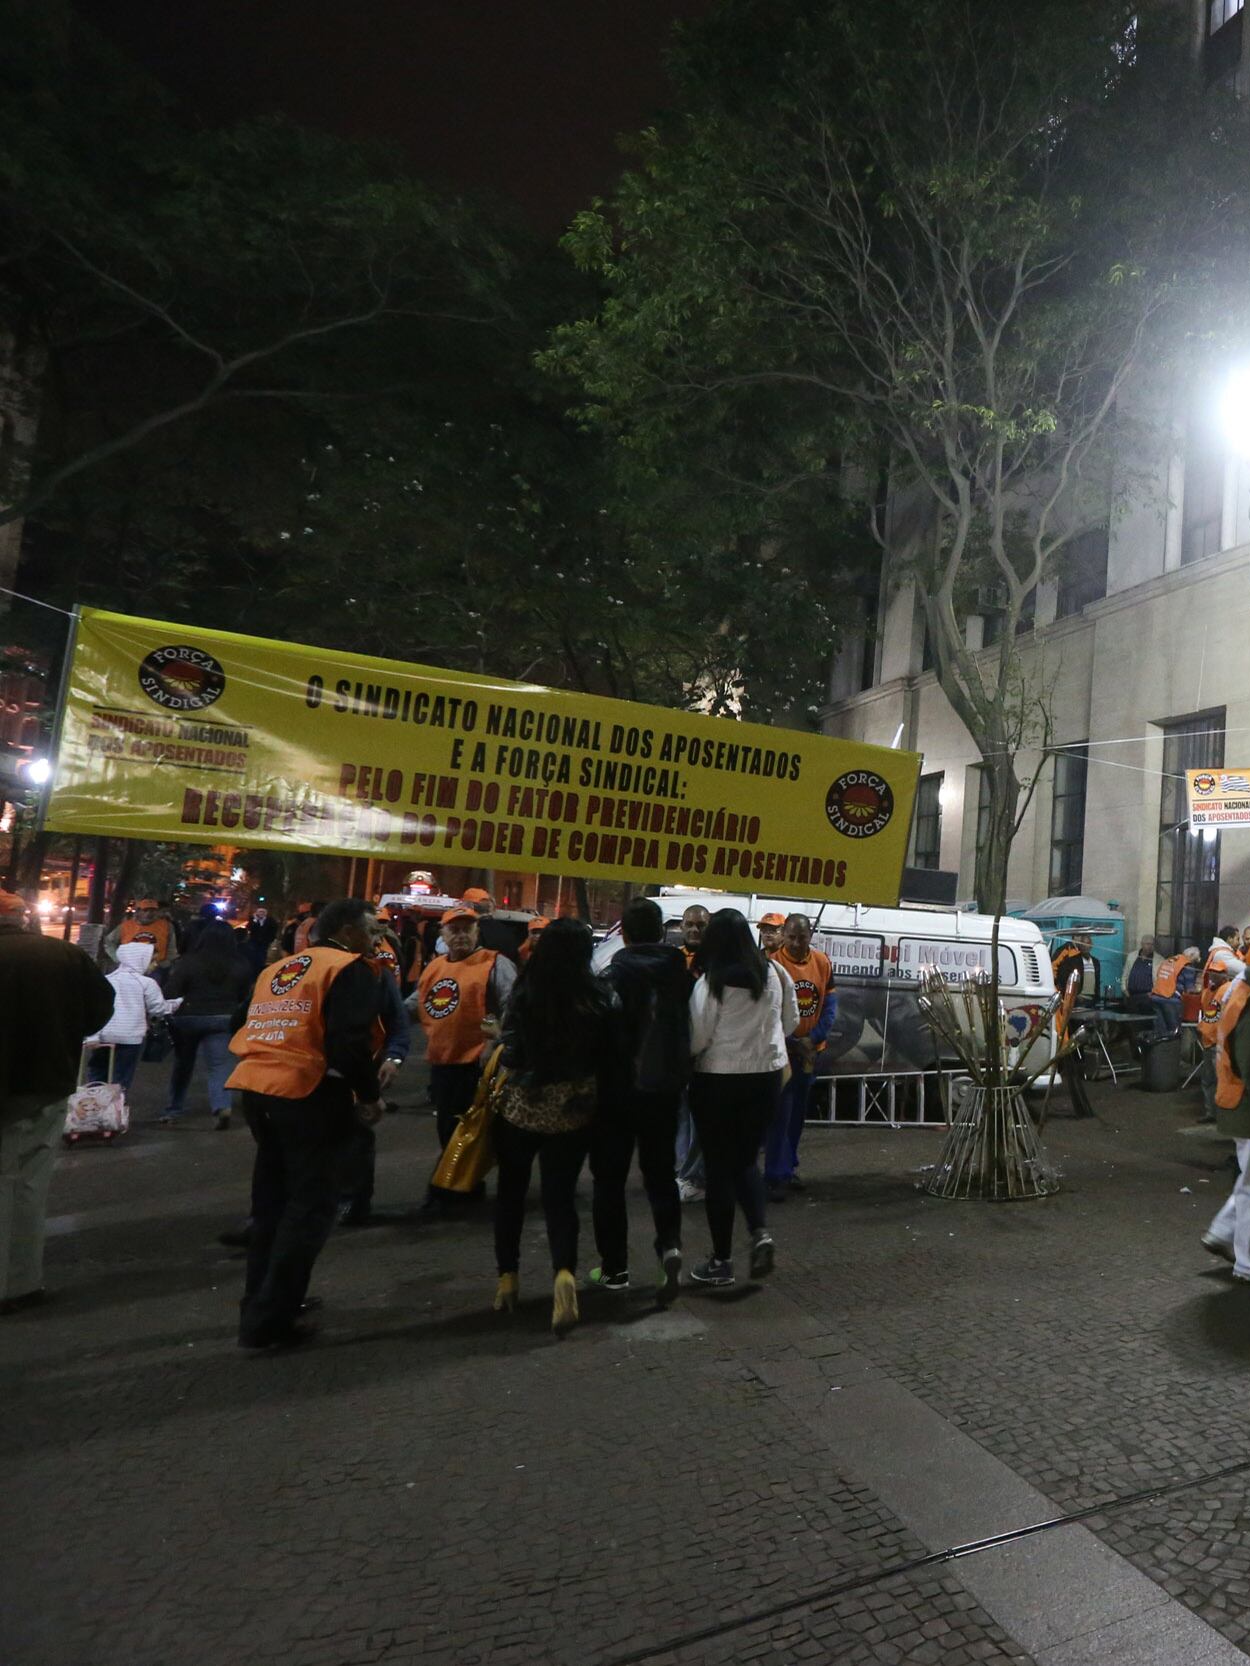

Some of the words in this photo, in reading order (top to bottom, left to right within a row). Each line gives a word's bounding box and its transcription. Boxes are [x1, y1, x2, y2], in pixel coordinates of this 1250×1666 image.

[153, 648, 214, 671] FORÇA
[91, 711, 175, 738] SINDICATO
[178, 724, 249, 748] NACIONAL
[305, 675, 324, 709] O
[333, 679, 478, 732] SINDICATO
[485, 704, 601, 751] NACIONAL
[609, 724, 654, 759] DOS
[659, 733, 801, 781] APOSENTADOS
[129, 740, 248, 769] APOSENTADOS
[450, 738, 464, 769] E
[470, 741, 486, 773] A
[495, 745, 571, 788] FORÇA
[579, 757, 688, 800] SINDICAL:
[838, 772, 887, 796] FORÇA
[339, 762, 403, 803] PELO
[410, 772, 459, 809] FIM
[465, 780, 499, 814] DO
[506, 784, 580, 823] FATOR
[585, 795, 761, 844] PREVIDENCIÁRIO
[1192, 802, 1223, 811] SINDICATO
[827, 804, 890, 837] SINDICAL
[1192, 814, 1206, 822] DOS
[401, 812, 437, 847] DO
[444, 816, 525, 855] PODER
[531, 826, 562, 859] DE
[567, 830, 660, 869] COMPRA
[665, 841, 708, 874] DOS
[712, 846, 847, 888] APOSENTADOS
[918, 944, 986, 968] Móvel
[794, 982, 814, 991] ORÇA
